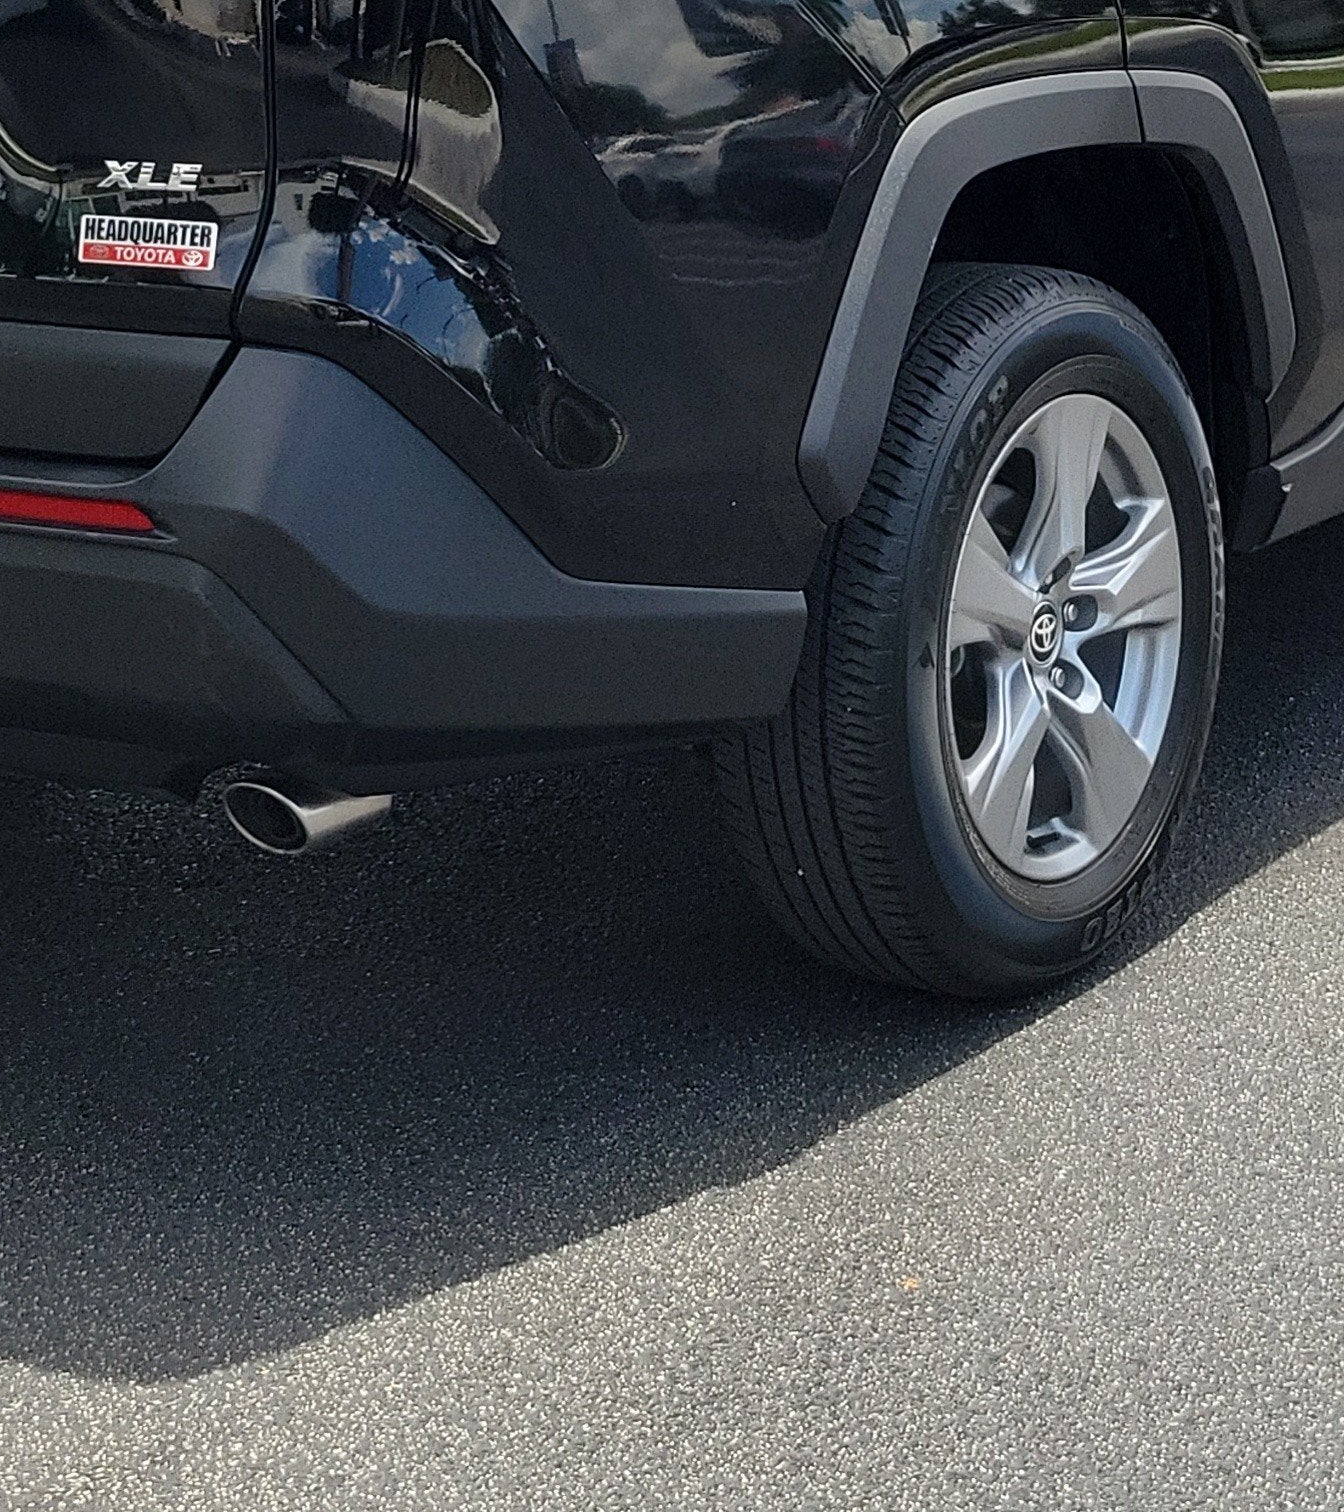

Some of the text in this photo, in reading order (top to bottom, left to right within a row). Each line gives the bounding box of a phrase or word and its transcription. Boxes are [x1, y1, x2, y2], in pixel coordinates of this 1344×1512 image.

[96, 159, 204, 192] XLE
[84, 217, 212, 248] HEADQUARTER
[114, 246, 176, 264] TOYOTA
